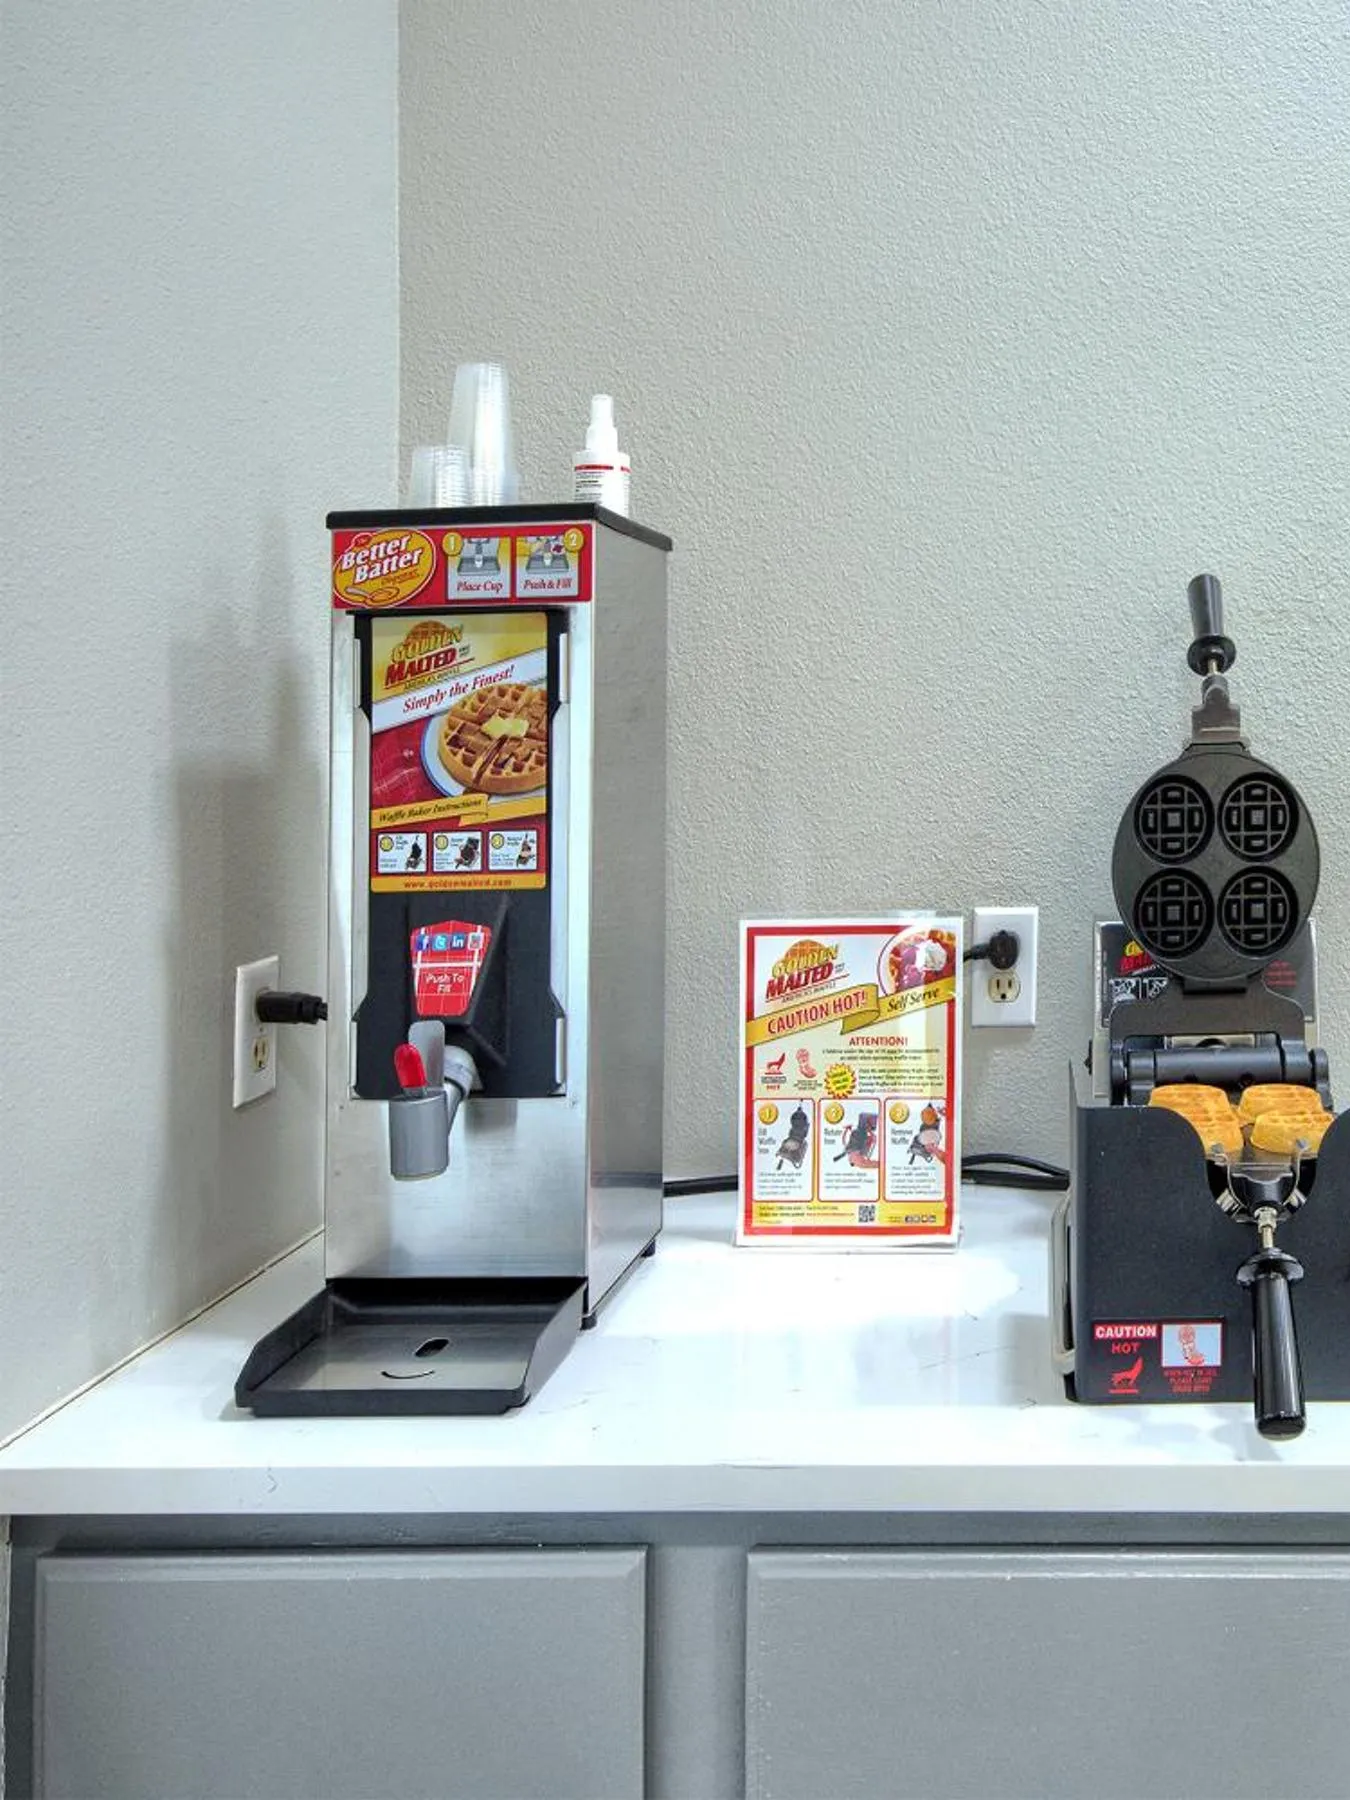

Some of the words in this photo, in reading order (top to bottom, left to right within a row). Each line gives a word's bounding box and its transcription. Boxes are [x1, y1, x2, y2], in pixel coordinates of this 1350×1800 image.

[569, 533, 577, 546] 2
[342, 535, 412, 570] Better
[354, 548, 422, 584] Batter
[456, 579, 482, 591] Place
[483, 579, 503, 594] Cup
[523, 579, 546, 590] Push
[556, 578, 572, 589] Fill
[391, 624, 464, 664] GOLDEN
[385, 648, 458, 687] MALTED
[403, 689, 447, 713] Simply
[449, 682, 469, 697] the
[471, 664, 515, 690] Finest!
[379, 809, 406, 823] Waffle
[408, 806, 432, 818] Baker
[432, 799, 482, 814] Instructions
[771, 940, 839, 978] GOLDEN
[425, 973, 450, 984] Push
[451, 973, 465, 983] To
[437, 984, 452, 993] Fill
[766, 962, 834, 998] MALTED
[767, 1004, 830, 1034] CAUTION
[832, 990, 866, 1014] HOT!
[887, 995, 908, 1012] Self
[909, 988, 940, 1005] Serve
[849, 1036, 908, 1046] ATTENTION!
[1095, 1325, 1157, 1338] CAUTION
[1112, 1342, 1140, 1354] HOT
